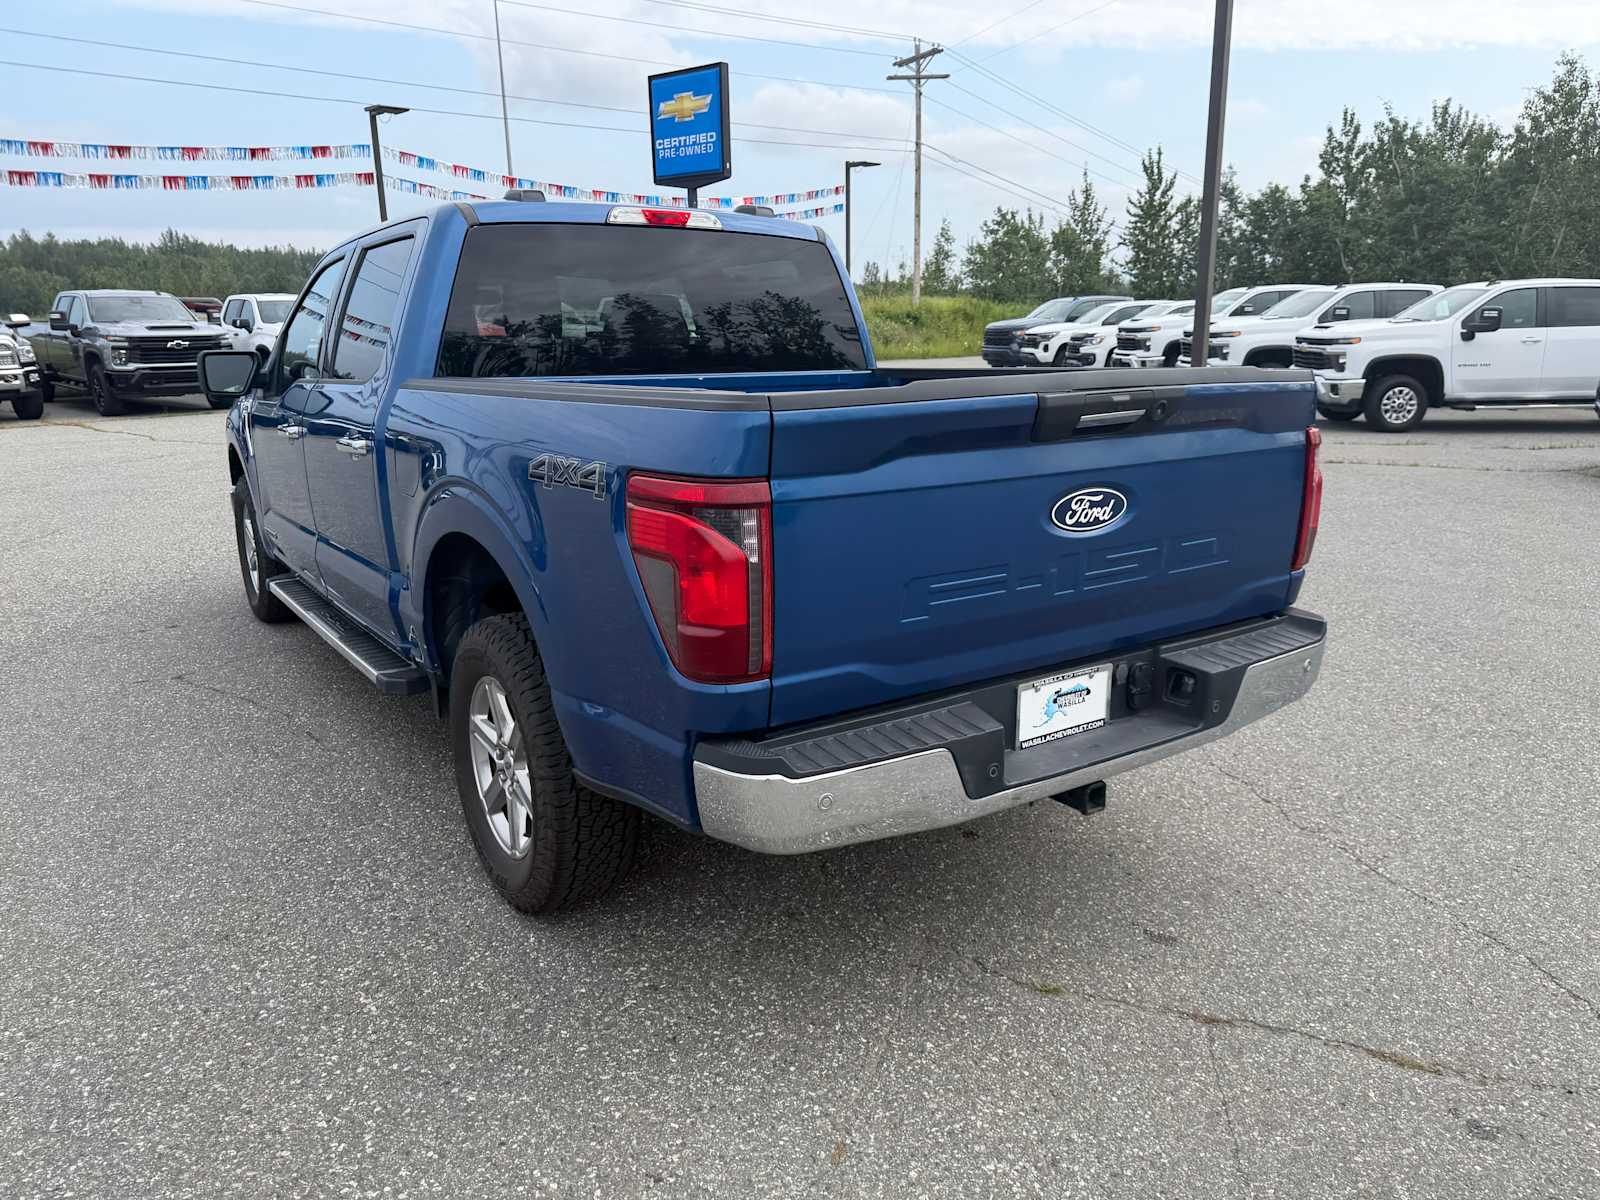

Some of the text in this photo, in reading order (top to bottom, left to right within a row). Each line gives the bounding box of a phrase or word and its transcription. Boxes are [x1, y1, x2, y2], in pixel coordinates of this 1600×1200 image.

[656, 131, 717, 149] CERTIFIED
[659, 143, 714, 159] PRE-OWNED
[1065, 494, 1115, 525] Ford
[899, 528, 1238, 624] F-150
[1057, 697, 1086, 709] WASILLA
[1021, 720, 1104, 749] WASILLACHEVROLET.COM
